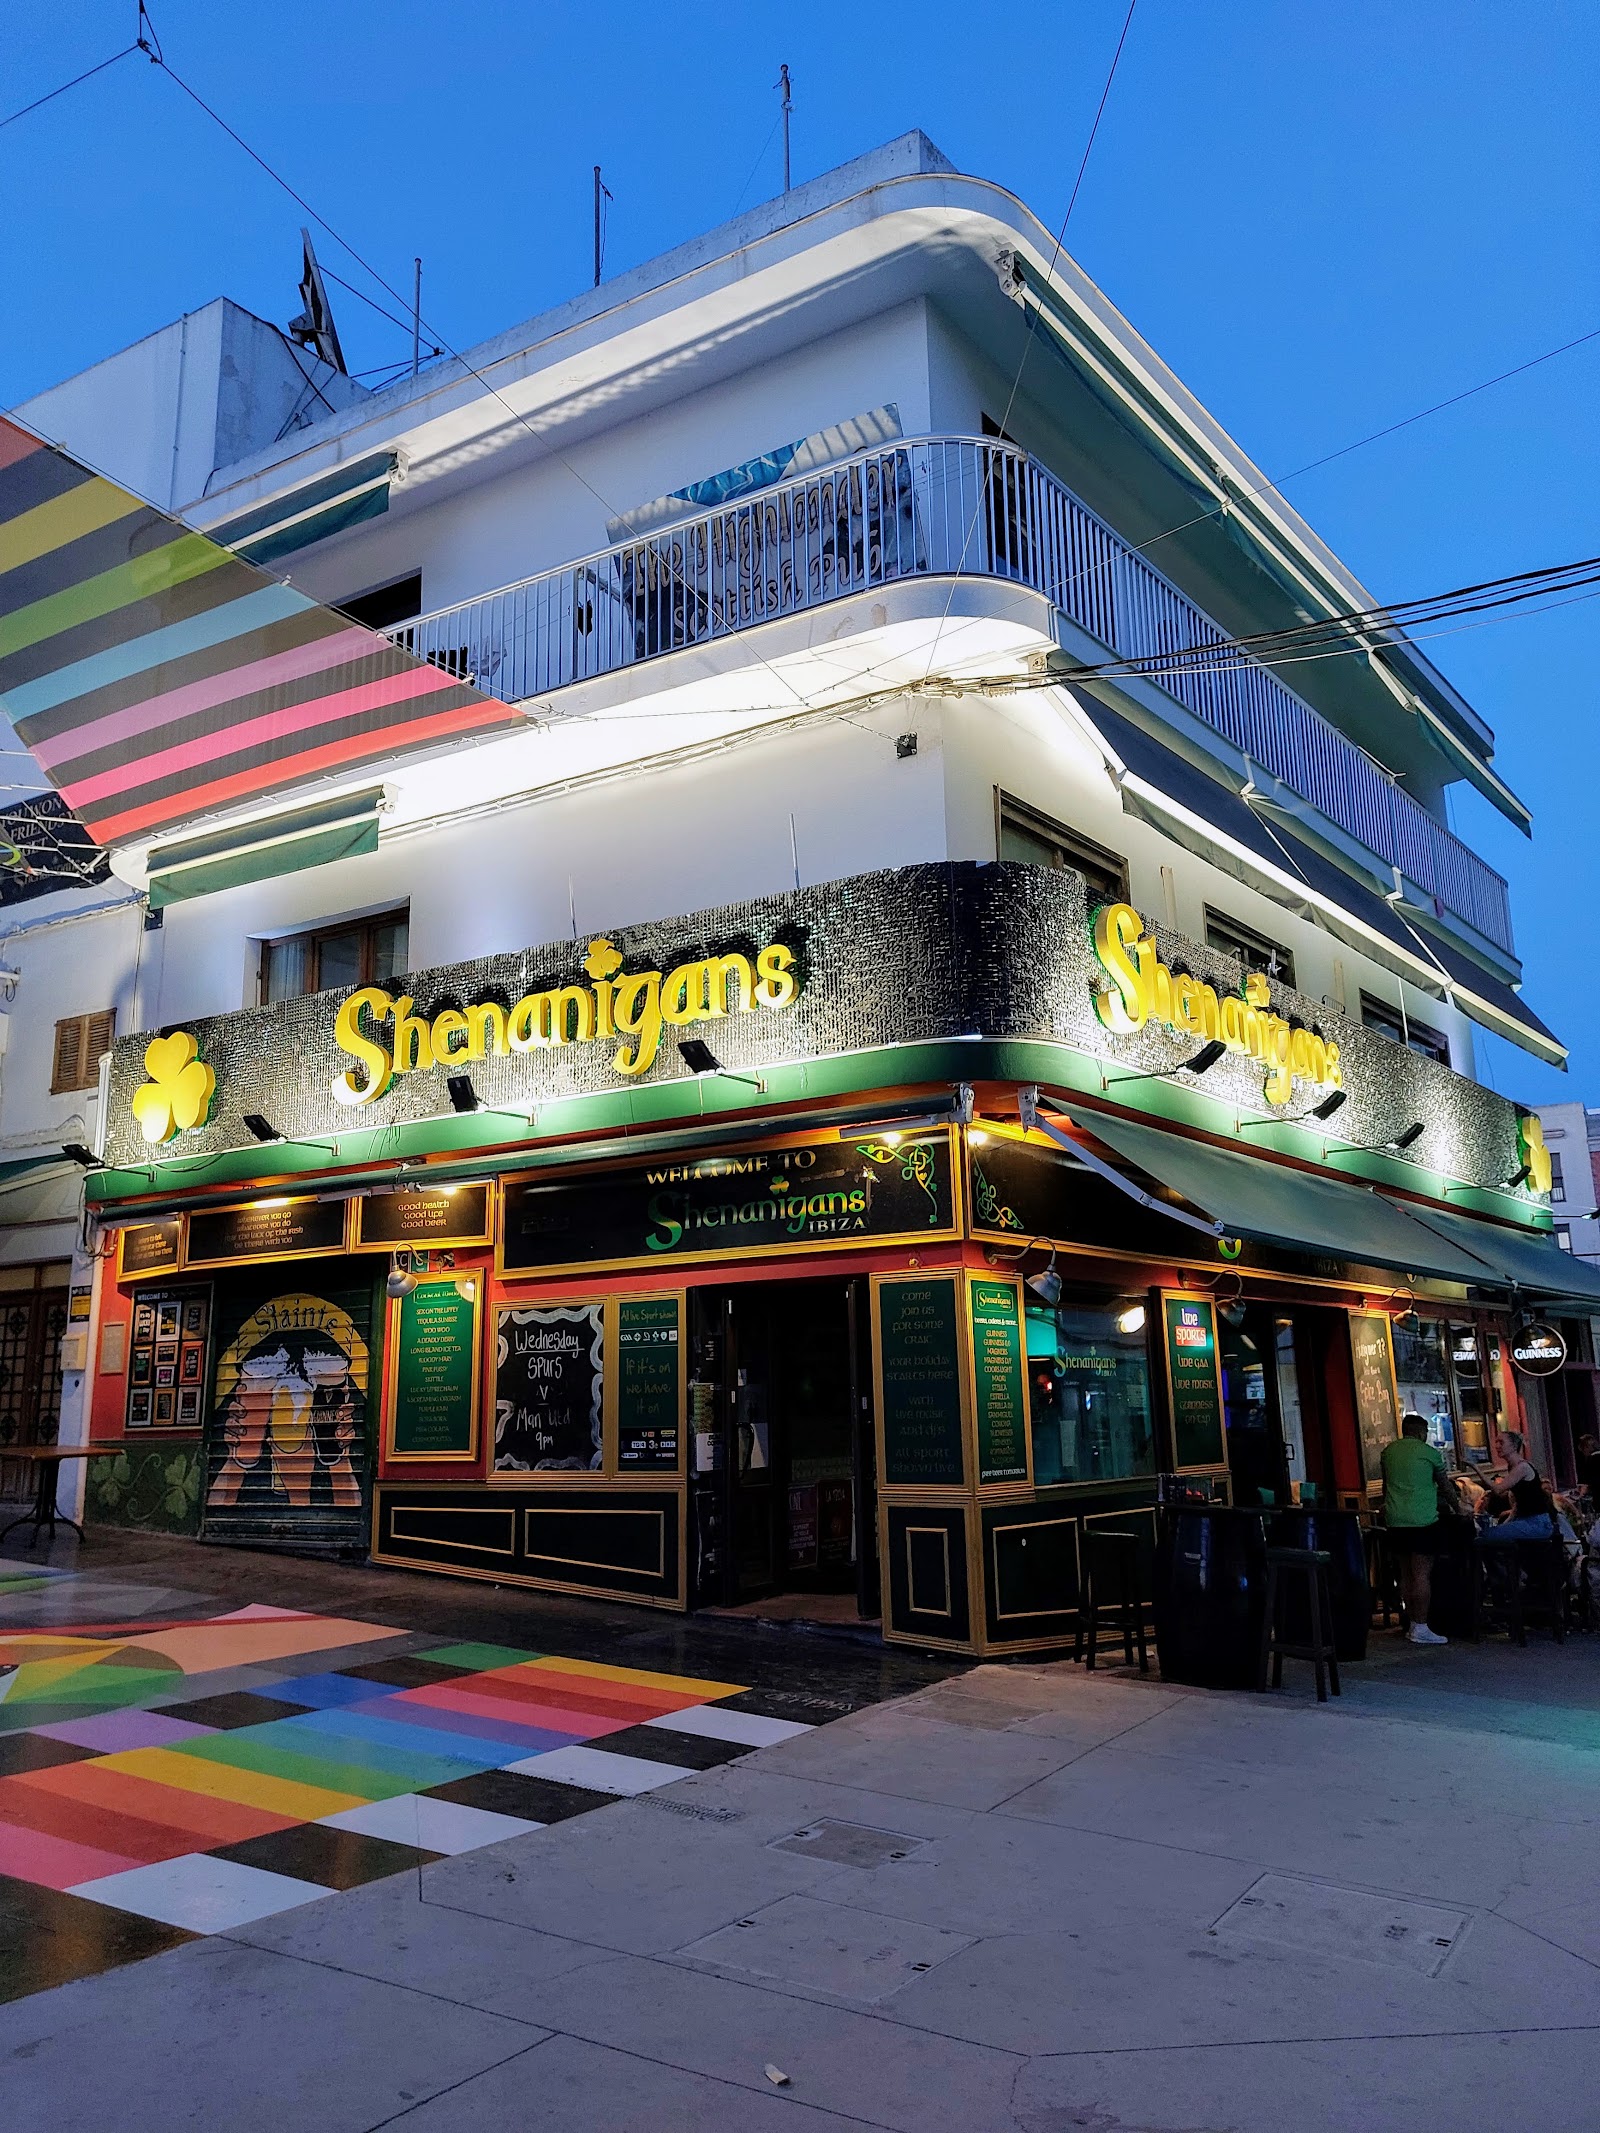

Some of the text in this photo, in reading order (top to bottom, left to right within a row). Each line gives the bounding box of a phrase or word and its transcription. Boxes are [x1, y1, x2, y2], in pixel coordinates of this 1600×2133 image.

[622, 450, 902, 595] The Highlander
[673, 530, 881, 644] Scottish Pub
[1095, 903, 1343, 1105] Shenanigans
[332, 938, 801, 1106] Shenanigans
[646, 1150, 817, 1186] WELCOME TO
[645, 1176, 866, 1251] Shenanigans
[808, 1217, 868, 1235] IBIZA
[1181, 1308, 1199, 1326] live
[515, 1329, 584, 1358] Wednesday
[1175, 1327, 1207, 1345] sports
[1054, 1346, 1117, 1377] Shenanigans
[1513, 1346, 1563, 1361] GUINNESS
[658, 1362, 671, 1374] on
[644, 1379, 671, 1394] have
[516, 1407, 570, 1431] Man Utd
[535, 1431, 554, 1451] 9pm
